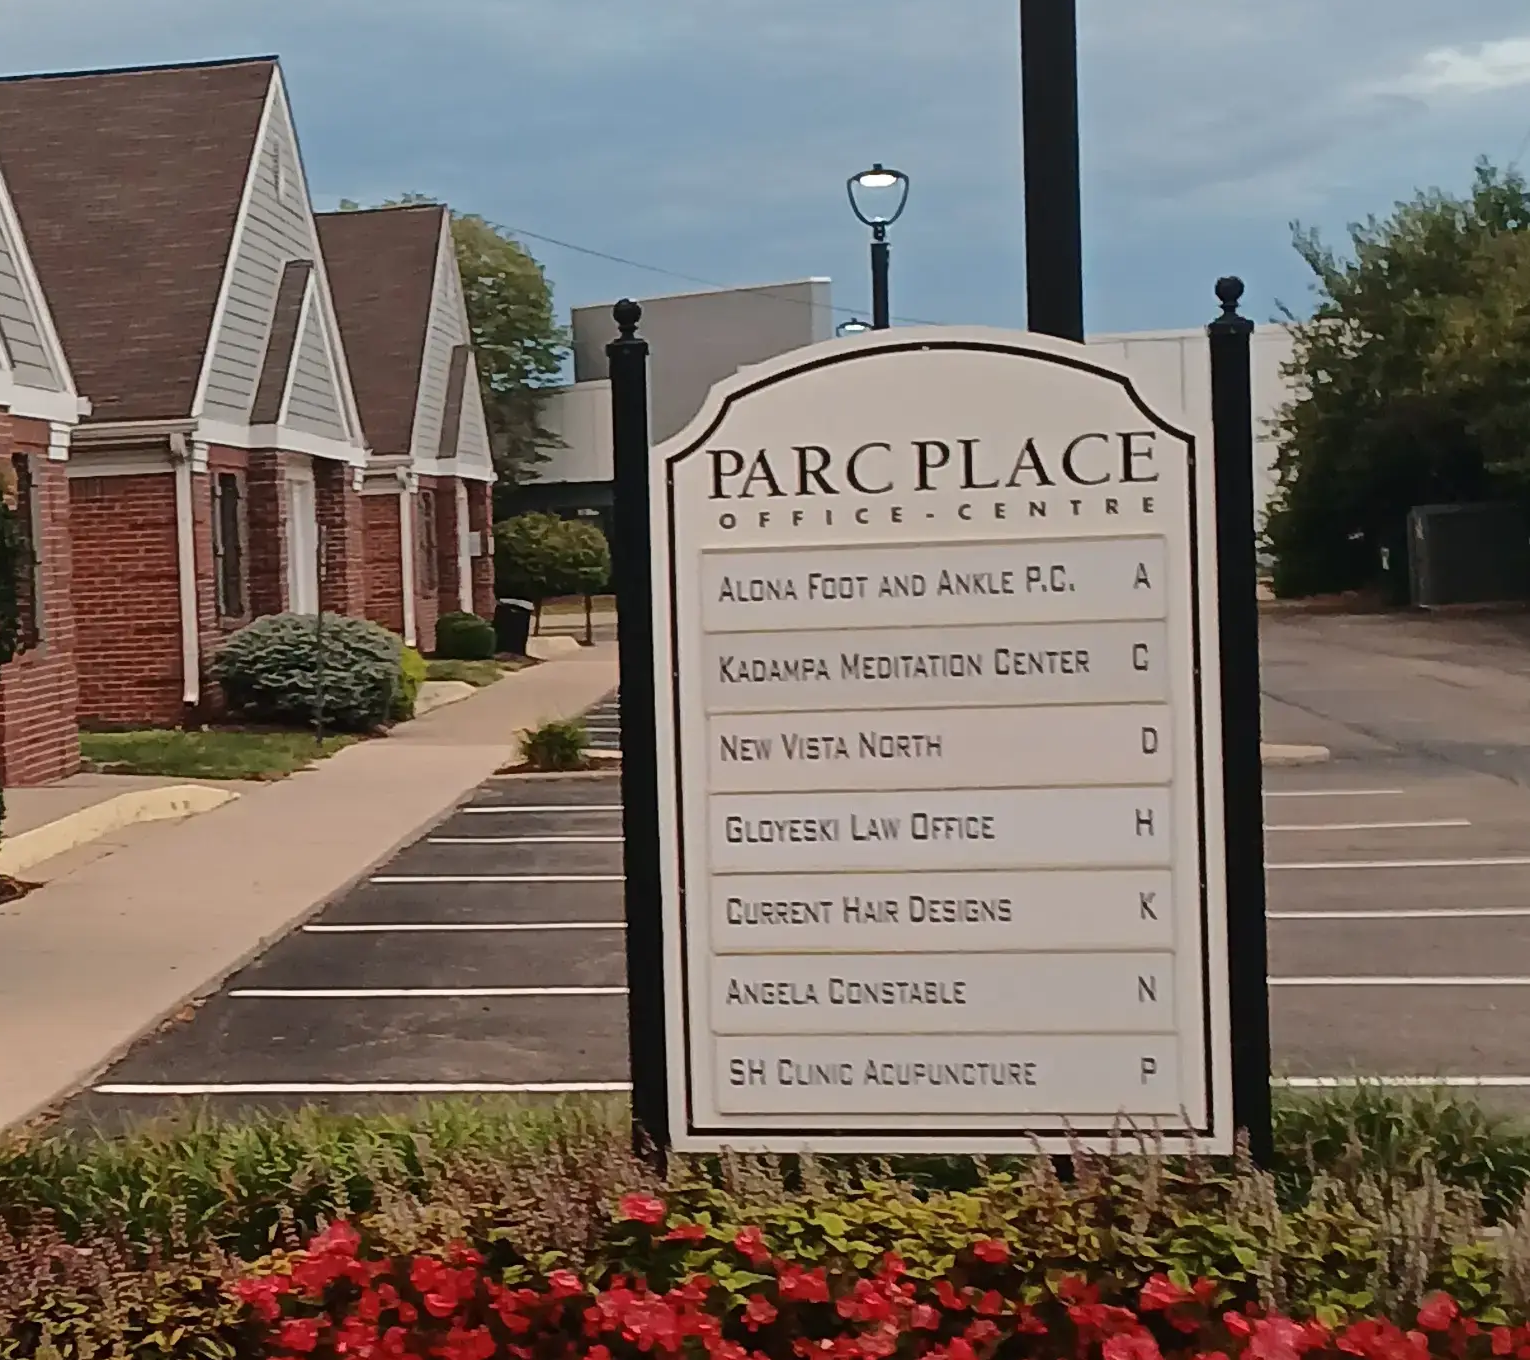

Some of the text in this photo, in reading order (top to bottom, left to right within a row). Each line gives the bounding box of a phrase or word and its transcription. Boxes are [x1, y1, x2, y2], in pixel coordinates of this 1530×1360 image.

[706, 430, 1161, 500] PARC PLACE
[717, 561, 1153, 603] ALONA FOOT AND ANKLE P.C. A
[718, 641, 1150, 684] KADAMPA MEDITATION CENTER C
[720, 725, 1159, 762] NEW VISTA NORTH D
[725, 807, 1156, 844] GLOYESKI LAW OFFICE H
[726, 890, 1159, 926] CURRENT HAIR DESIGNS K
[725, 974, 1158, 1006] ANGELA CONSTABLE N
[729, 1055, 1158, 1087] SH CLINIC ACUPUNCTURE P
